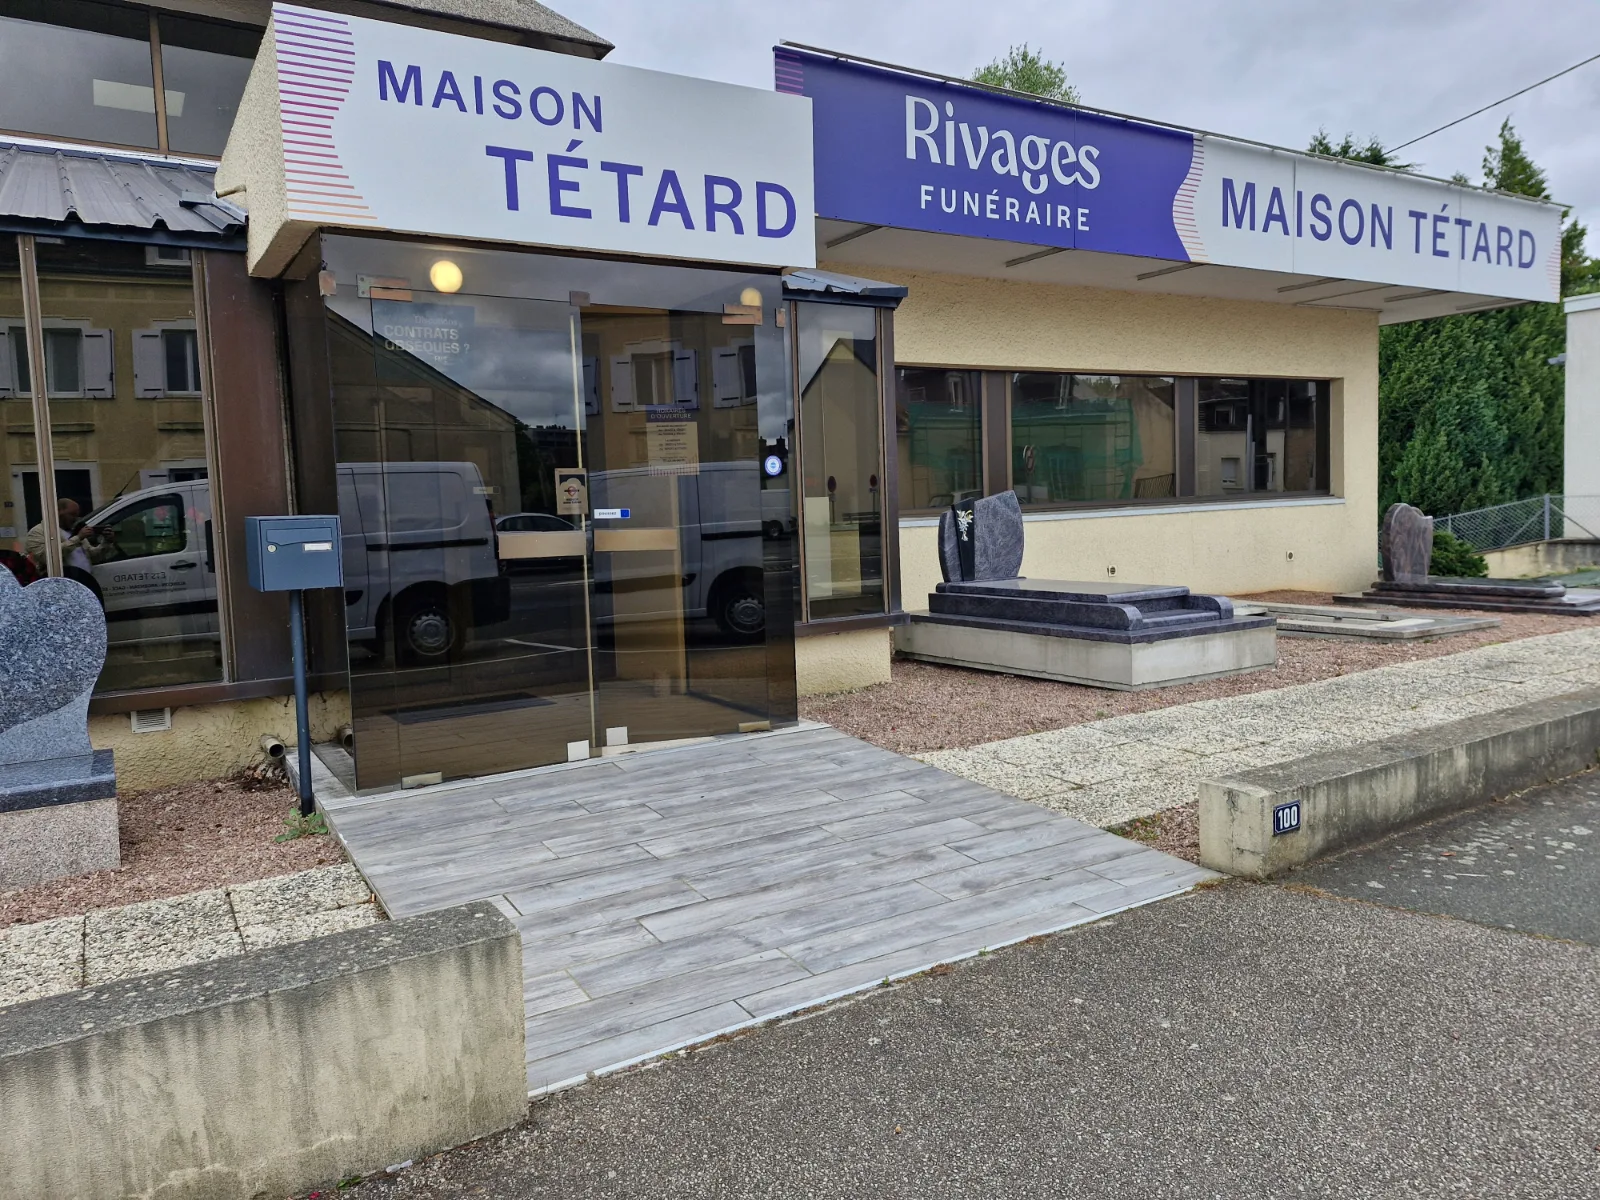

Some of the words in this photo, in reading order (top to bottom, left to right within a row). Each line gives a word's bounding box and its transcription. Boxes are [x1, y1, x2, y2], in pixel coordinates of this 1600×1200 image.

[377, 60, 603, 133] MAISON
[905, 95, 1101, 195] Rivages
[485, 139, 797, 239] TÉTARD
[920, 184, 1090, 231] FUNÉRAIRE
[1222, 177, 1393, 250] MAISON
[1408, 203, 1537, 269] TÉTARD
[384, 325, 459, 340] CONTRATS
[1278, 806, 1298, 830] 100
